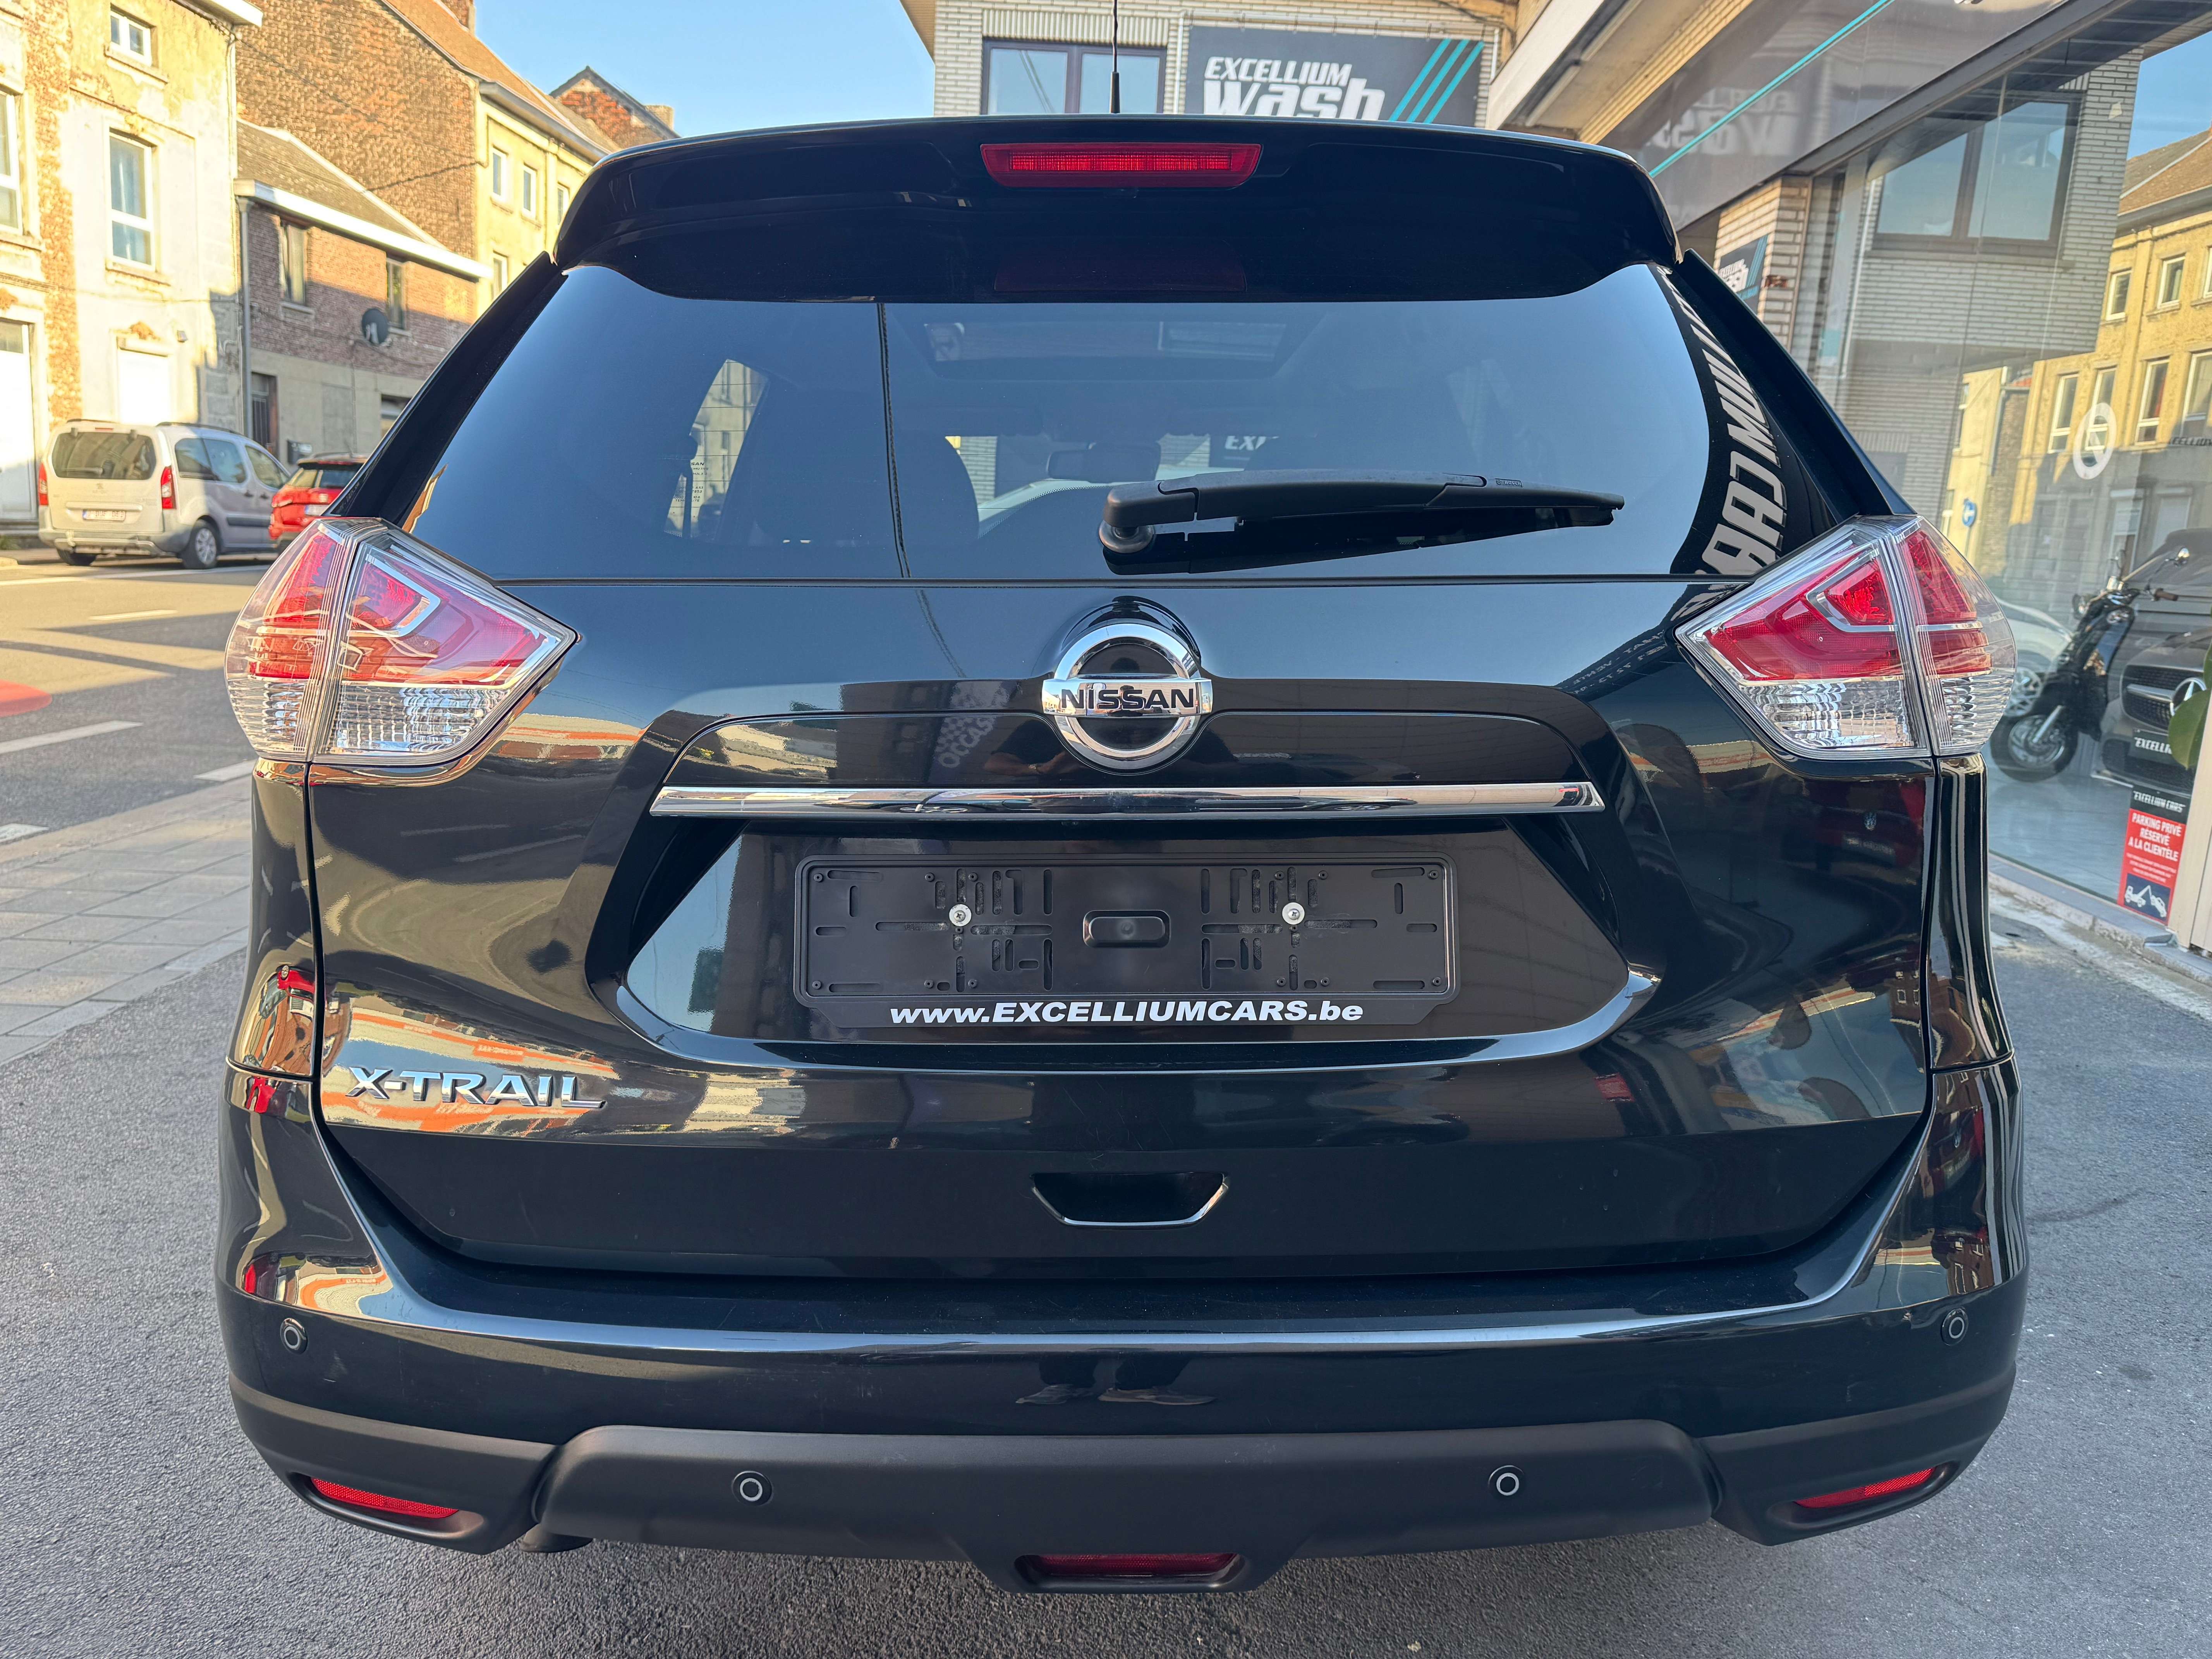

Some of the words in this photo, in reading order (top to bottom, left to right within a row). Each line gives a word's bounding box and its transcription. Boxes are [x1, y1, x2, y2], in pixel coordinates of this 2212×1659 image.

[1204, 57, 1352, 86] EXCELLIUM
[1061, 689, 1194, 709] NISSAN
[2132, 812, 2161, 830] PARKING
[2161, 821, 2182, 837] PRIVÉ
[2134, 838, 2143, 850] LA
[890, 1000, 1364, 1023] www.EXCELLIUMCARS.be
[345, 1066, 607, 1109] X-TRAIL
